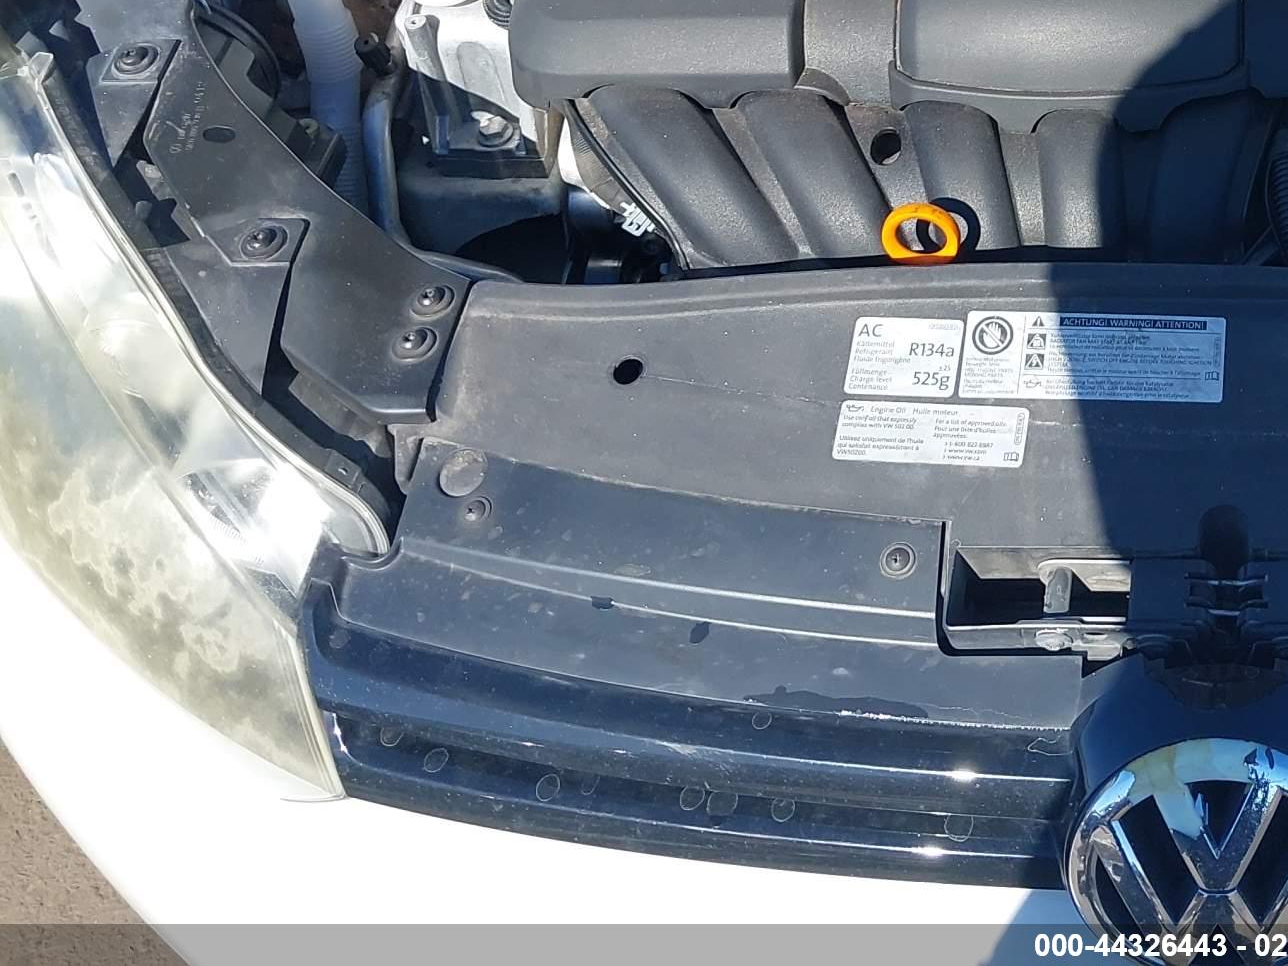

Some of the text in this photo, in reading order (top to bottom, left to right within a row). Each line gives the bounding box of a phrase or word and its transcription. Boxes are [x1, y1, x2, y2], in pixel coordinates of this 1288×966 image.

[859, 324, 883, 337] AC
[1110, 320, 1153, 328] WARNING!
[1154, 321, 1204, 329] ATTENTION!
[909, 342, 954, 357] R134a
[912, 372, 950, 390] 525g
[871, 406, 894, 414] Engine
